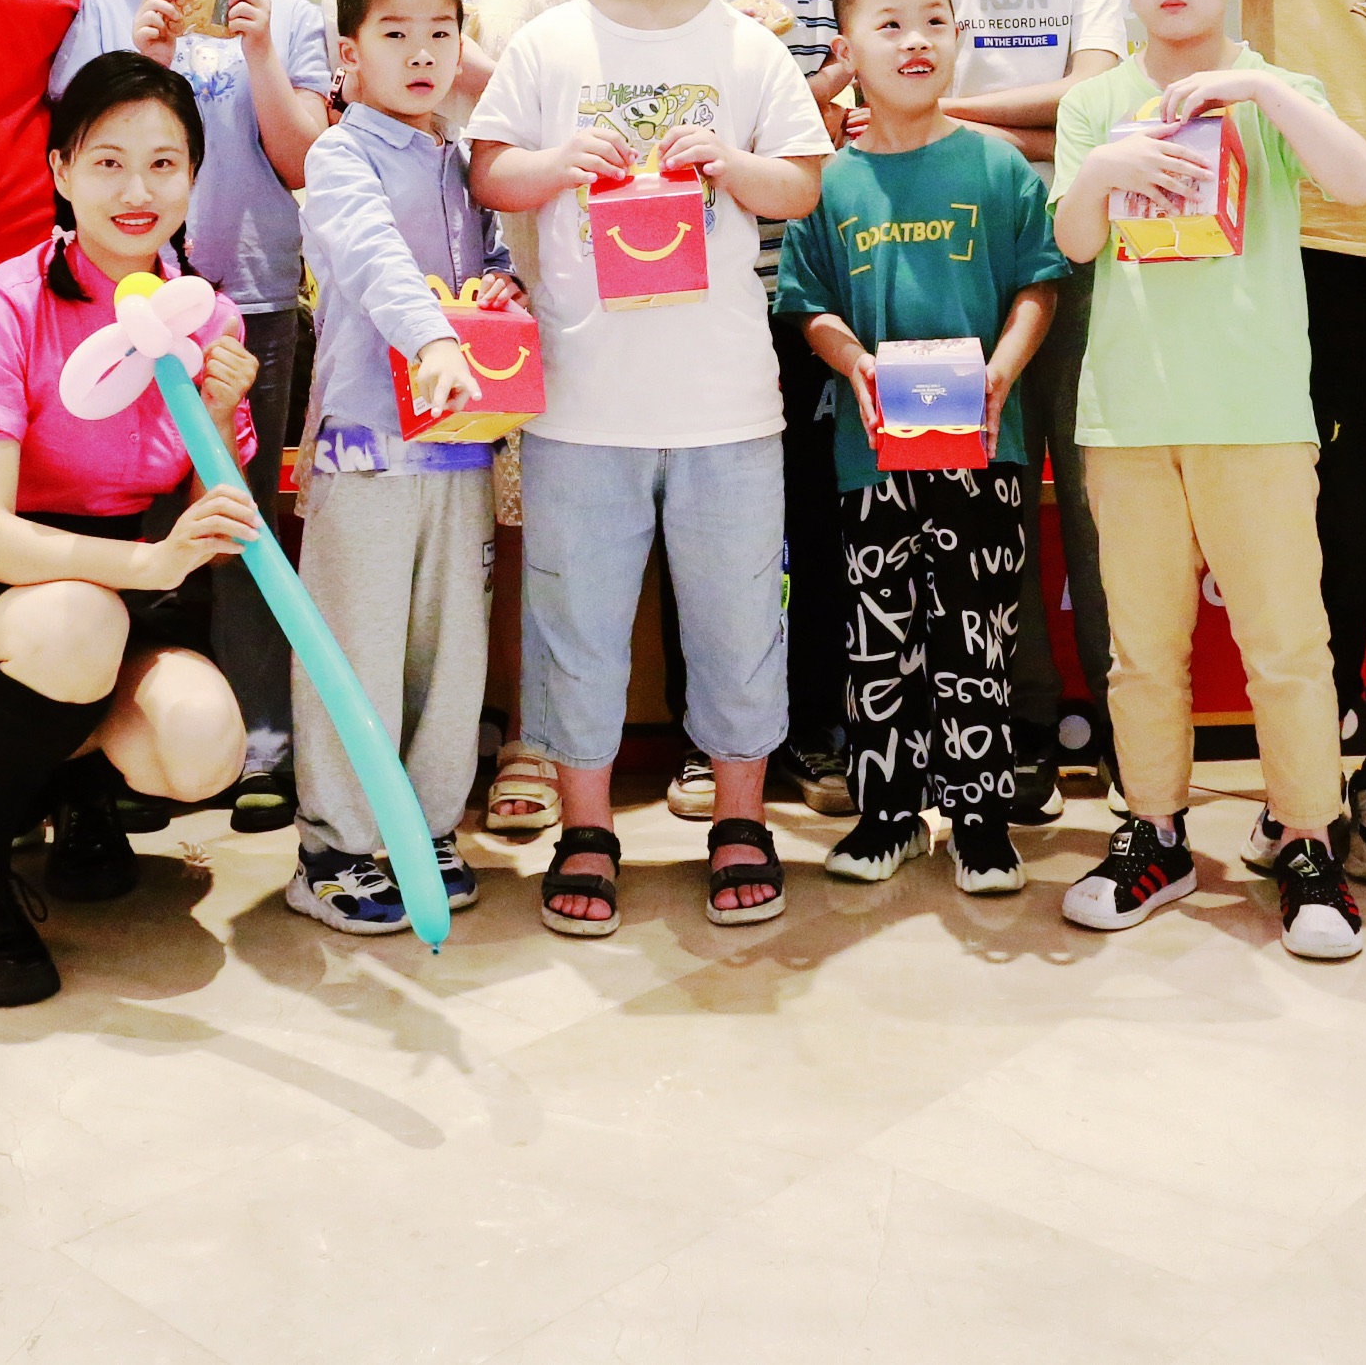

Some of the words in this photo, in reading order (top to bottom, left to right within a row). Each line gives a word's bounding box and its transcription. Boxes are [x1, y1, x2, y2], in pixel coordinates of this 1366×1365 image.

[956, 18, 985, 31] ORLD
[989, 17, 1036, 29] RECORD
[1012, 36, 1049, 46] FUTURE
[608, 82, 654, 106] HELLO
